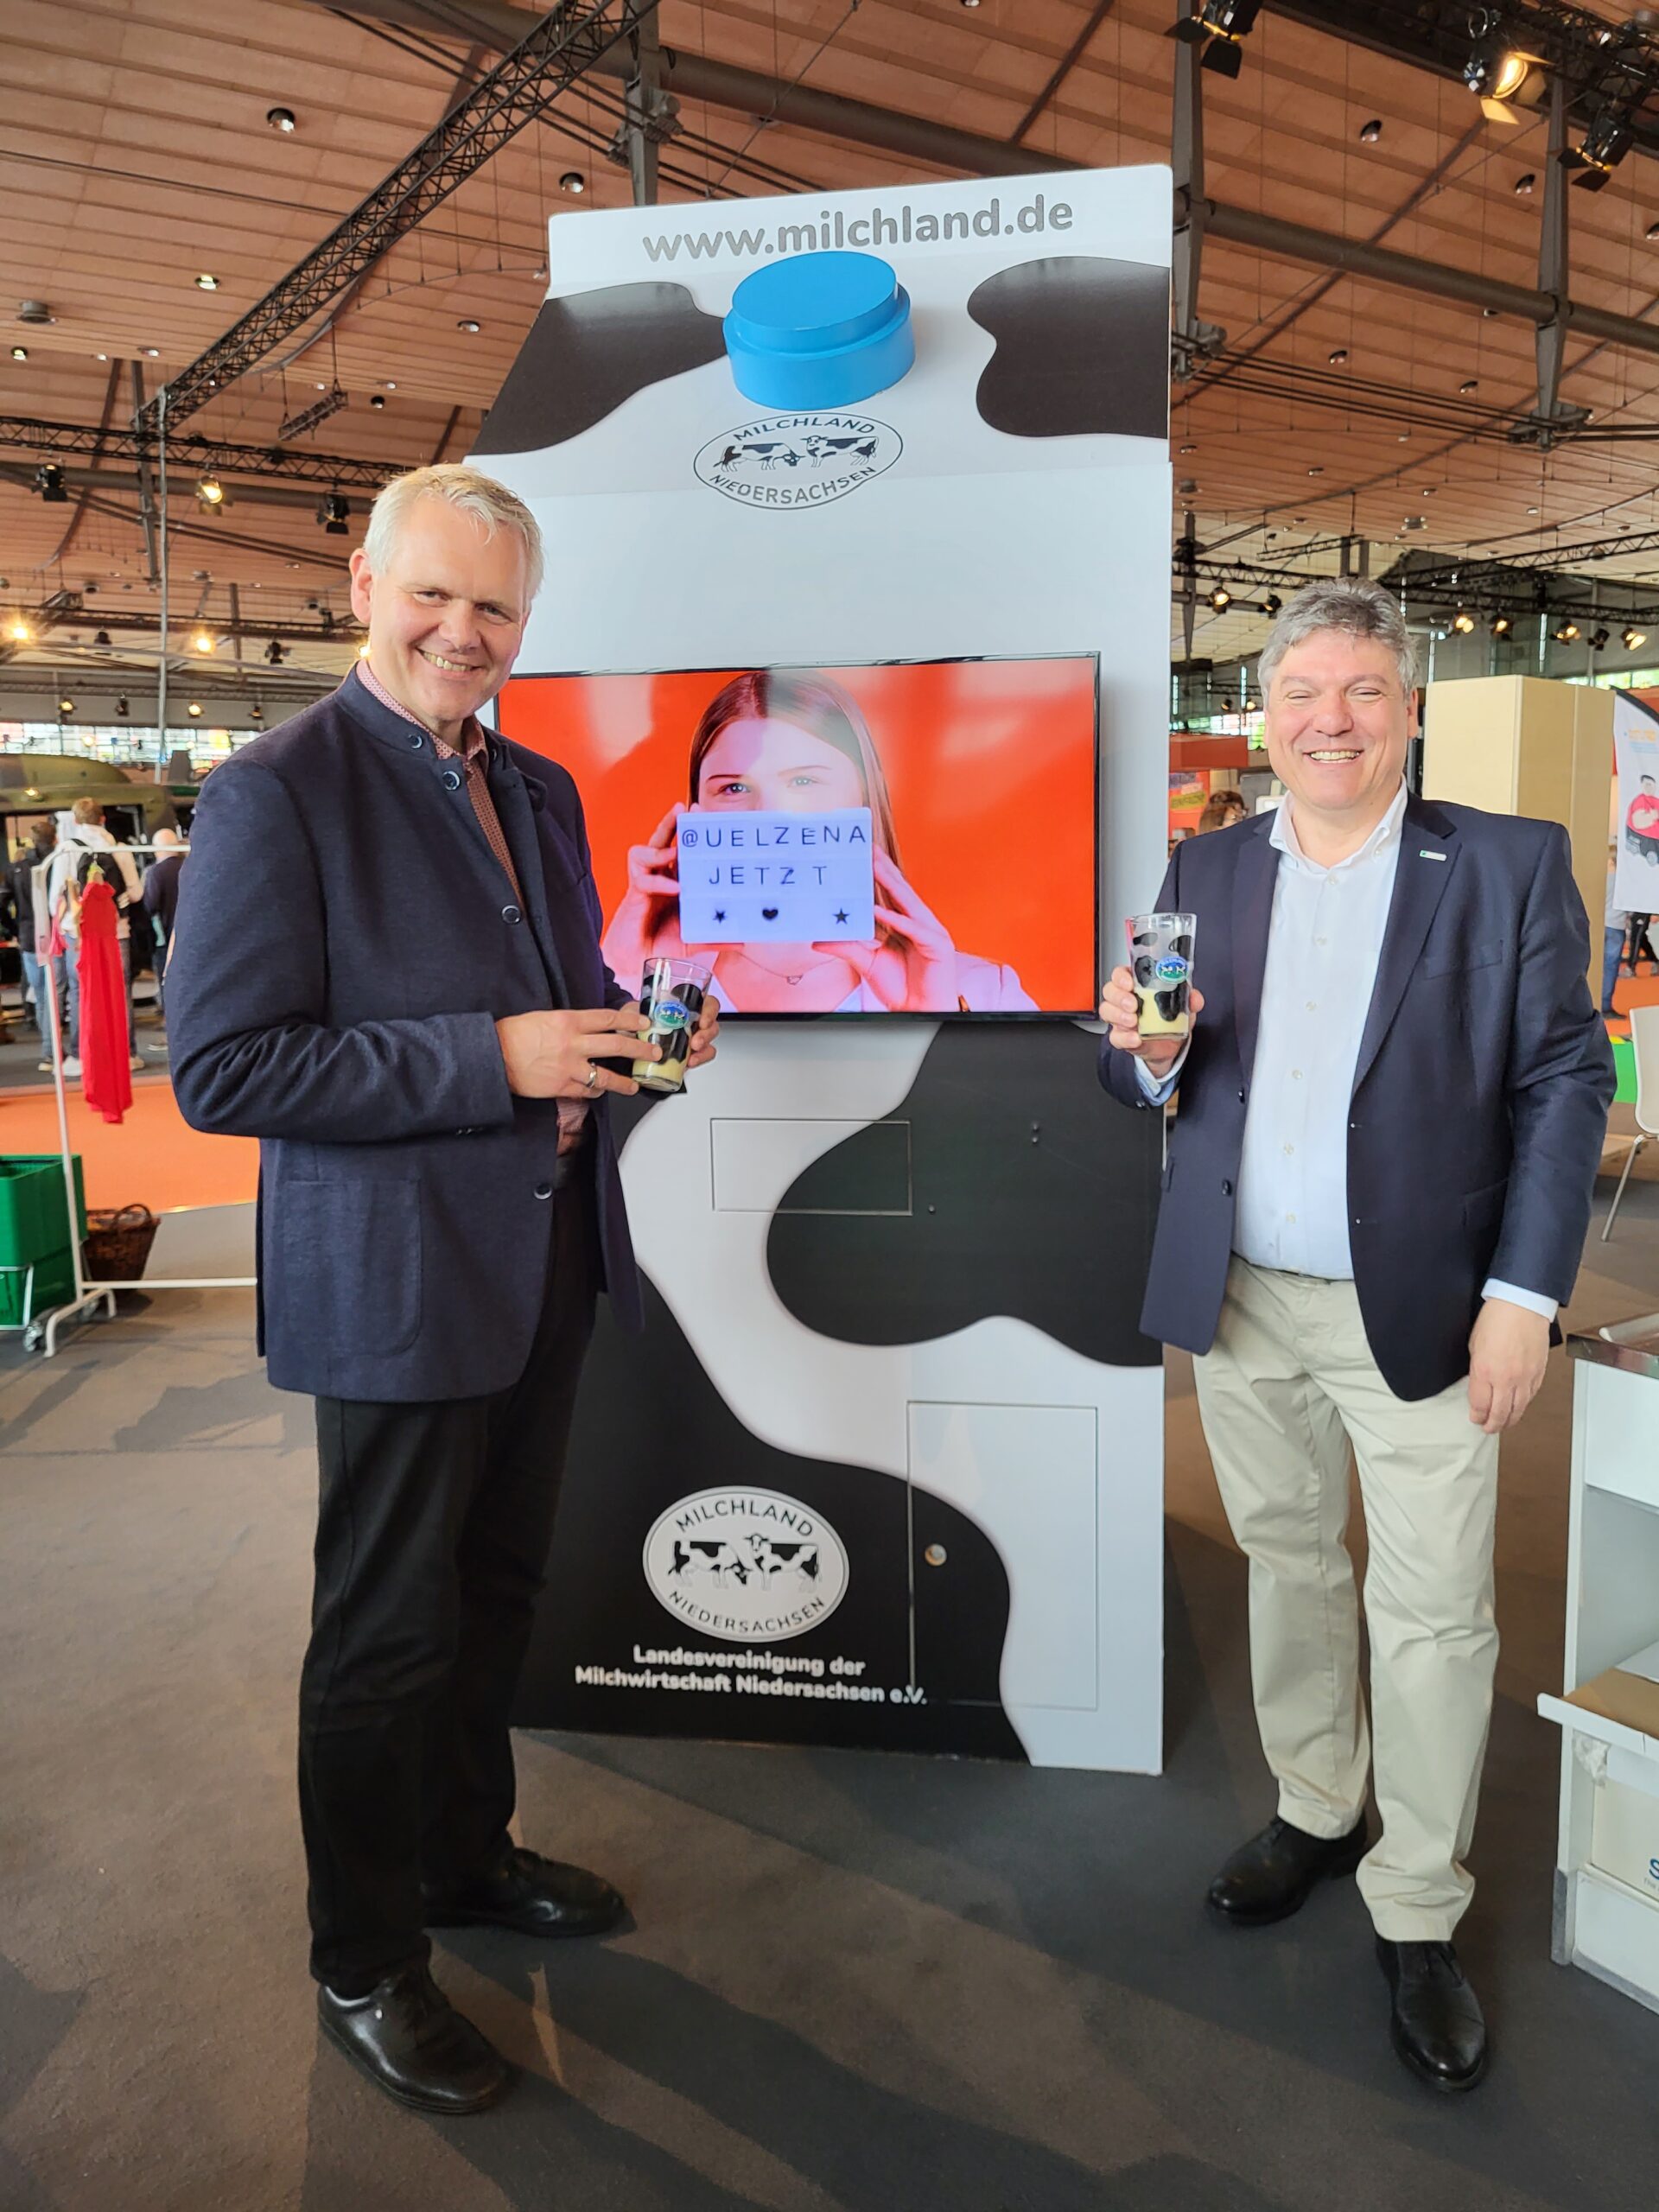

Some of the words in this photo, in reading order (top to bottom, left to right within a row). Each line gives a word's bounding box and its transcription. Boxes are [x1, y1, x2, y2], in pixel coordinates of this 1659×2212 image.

[643, 194, 1072, 262] www.milchland.de
[734, 417, 875, 442] MILCHLAND
[709, 467, 877, 504] NIEDERSACHSEN
[682, 825, 866, 848] @UELZENA
[676, 1499, 813, 1537] MILCHLAND
[669, 1591, 825, 1633] NIEDERSACHSEN
[633, 1644, 825, 1677] Landesvereinigung
[830, 1656, 866, 1675] der
[575, 1666, 732, 1692] Milchwirtschaft
[736, 1676, 885, 1702] Niedersachsen
[890, 1685, 928, 1705] e.V.
